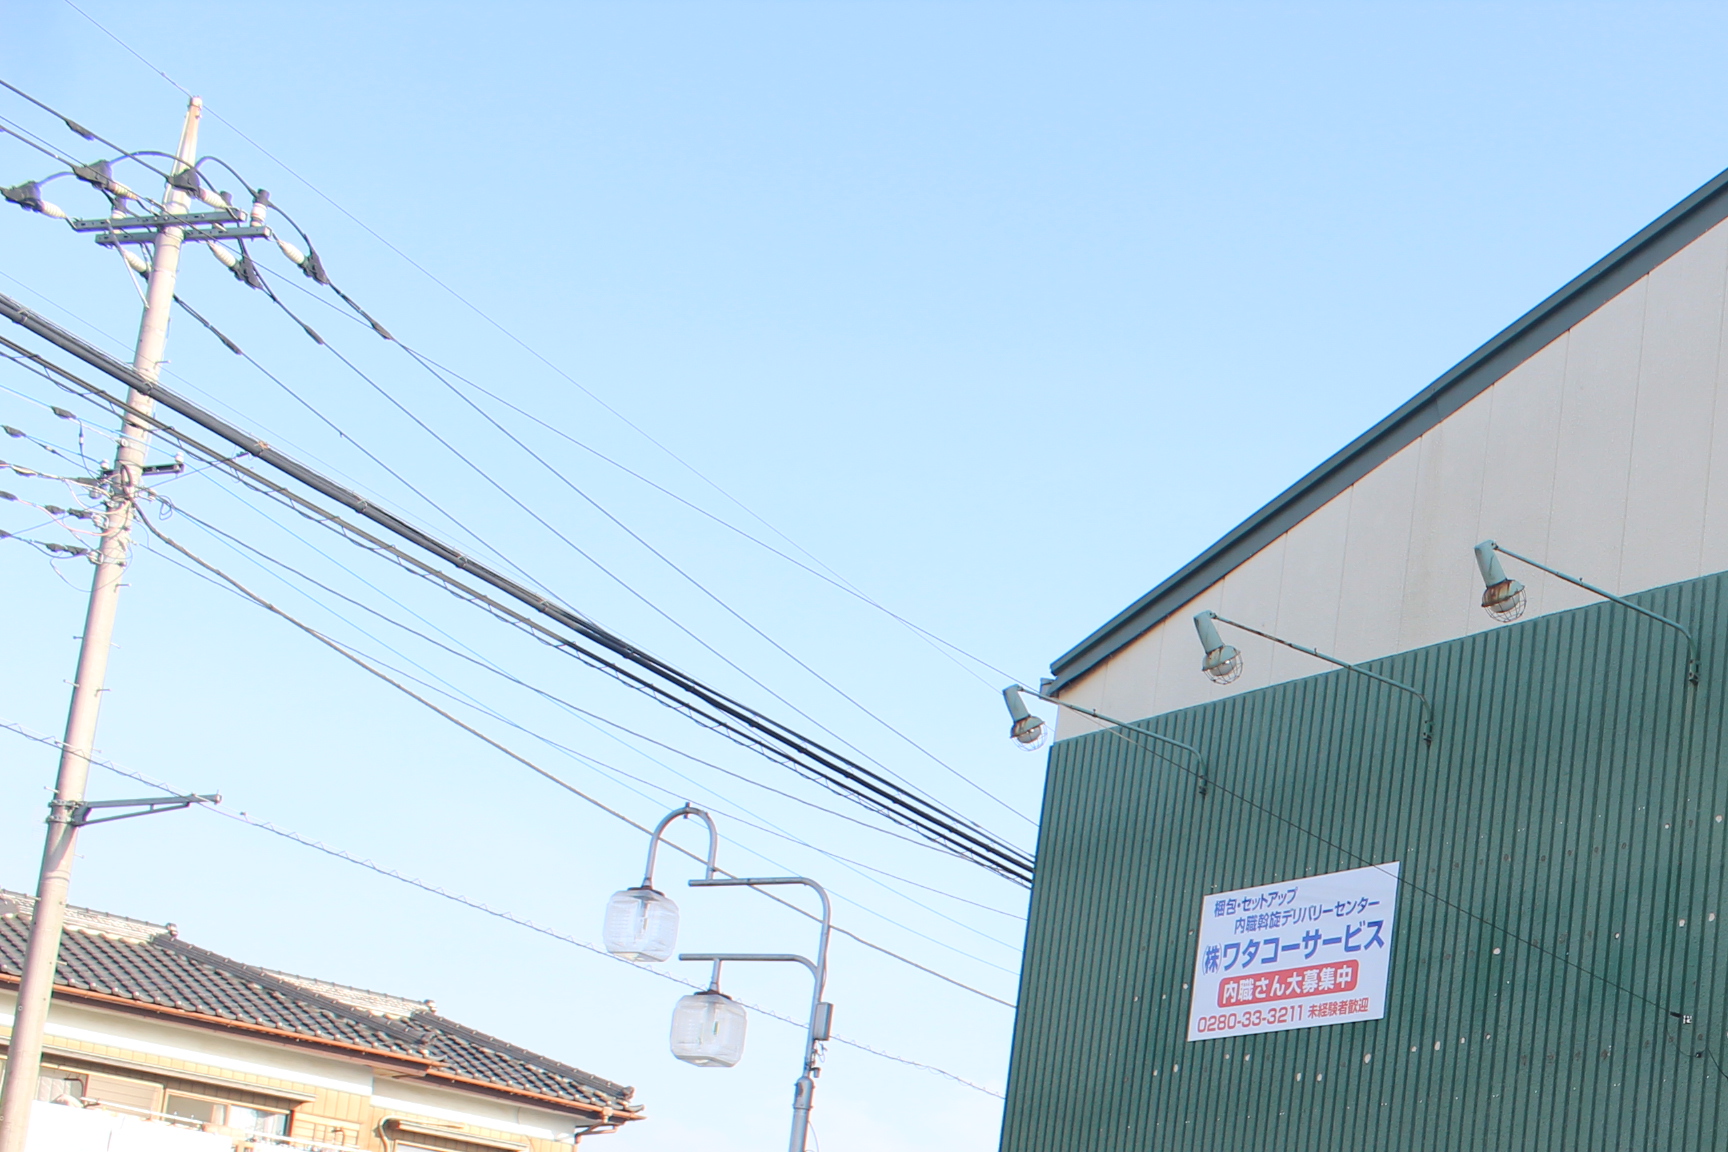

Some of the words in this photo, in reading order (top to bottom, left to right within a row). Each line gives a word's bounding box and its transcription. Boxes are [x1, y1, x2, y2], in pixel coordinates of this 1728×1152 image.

[1222, 965, 1353, 1004] 内職さん大募集中
[1197, 1004, 1304, 1033] 0280-33-3211
[1307, 997, 1369, 1019] 未経験者歓迎
